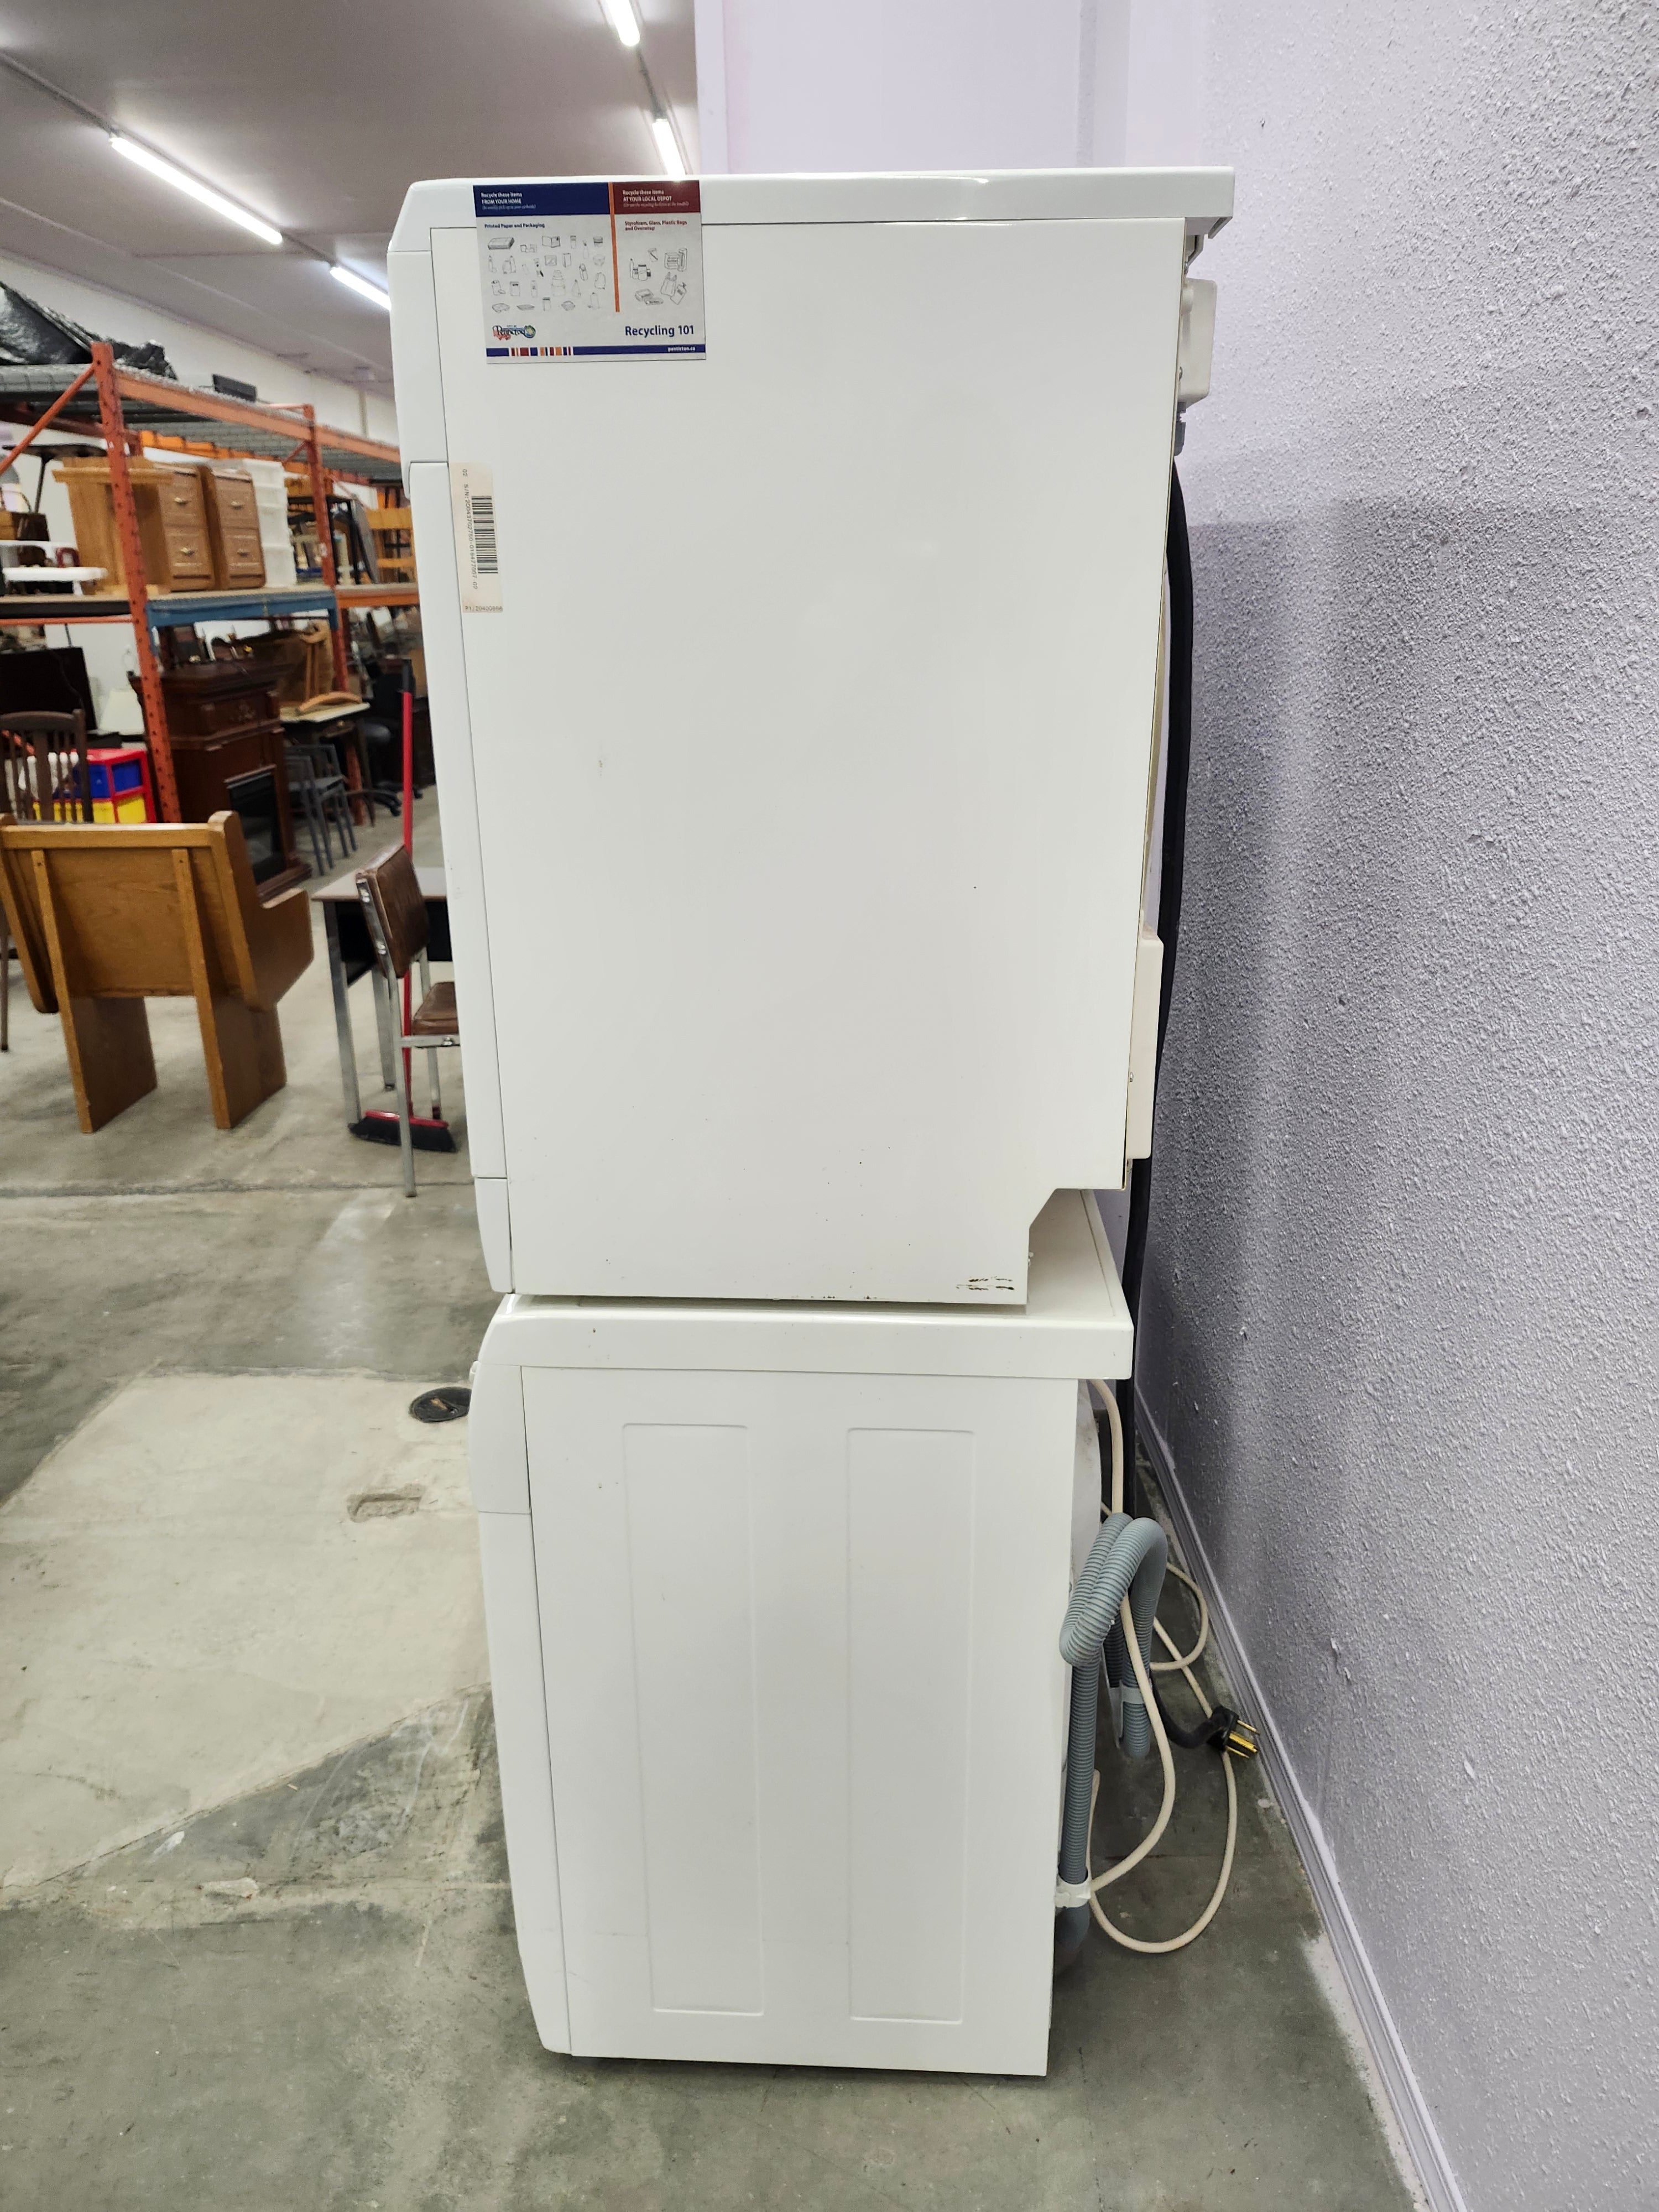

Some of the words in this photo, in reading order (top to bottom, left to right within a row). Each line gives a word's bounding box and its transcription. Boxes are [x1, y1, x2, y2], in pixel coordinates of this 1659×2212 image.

[625, 325, 675, 338] Recycling
[678, 325, 694, 335] 101
[463, 468, 468, 477] 02
